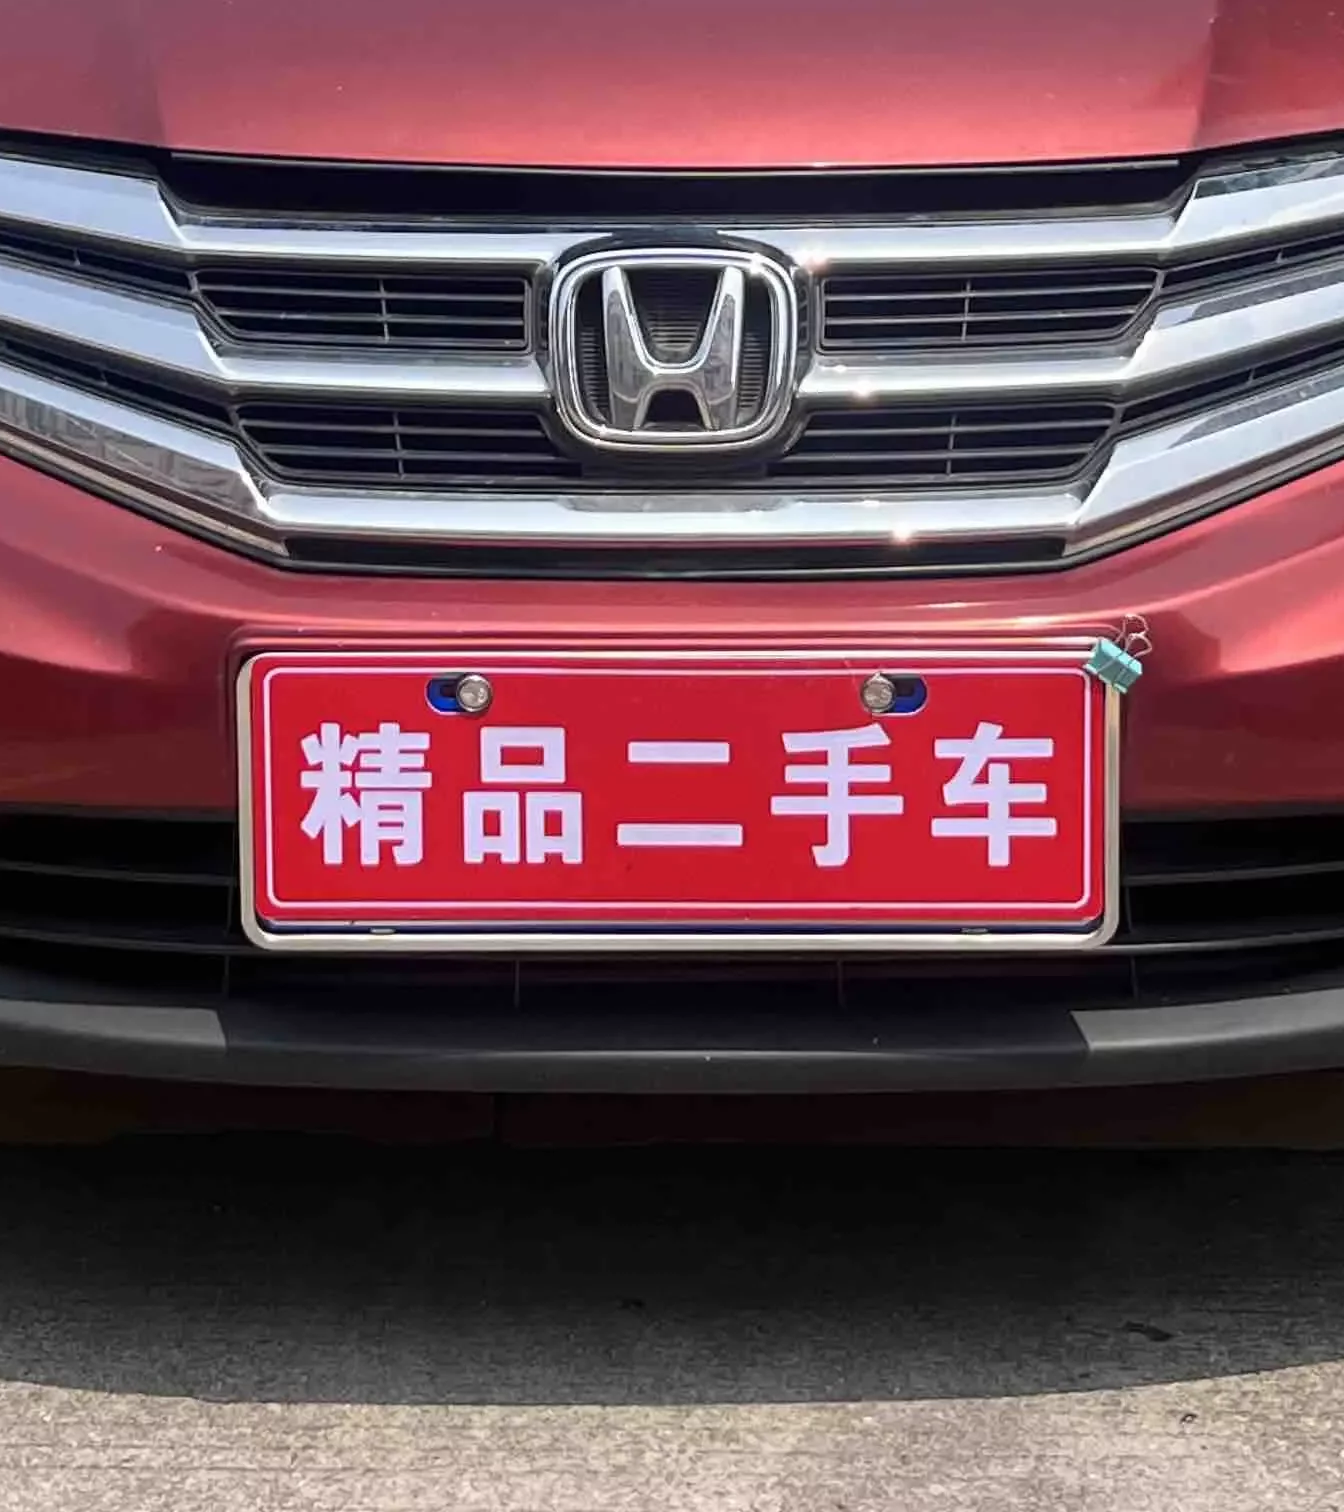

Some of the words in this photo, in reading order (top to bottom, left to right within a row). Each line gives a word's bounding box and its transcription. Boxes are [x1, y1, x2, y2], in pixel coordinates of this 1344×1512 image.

[299, 721, 1058, 867] 精品二手车
